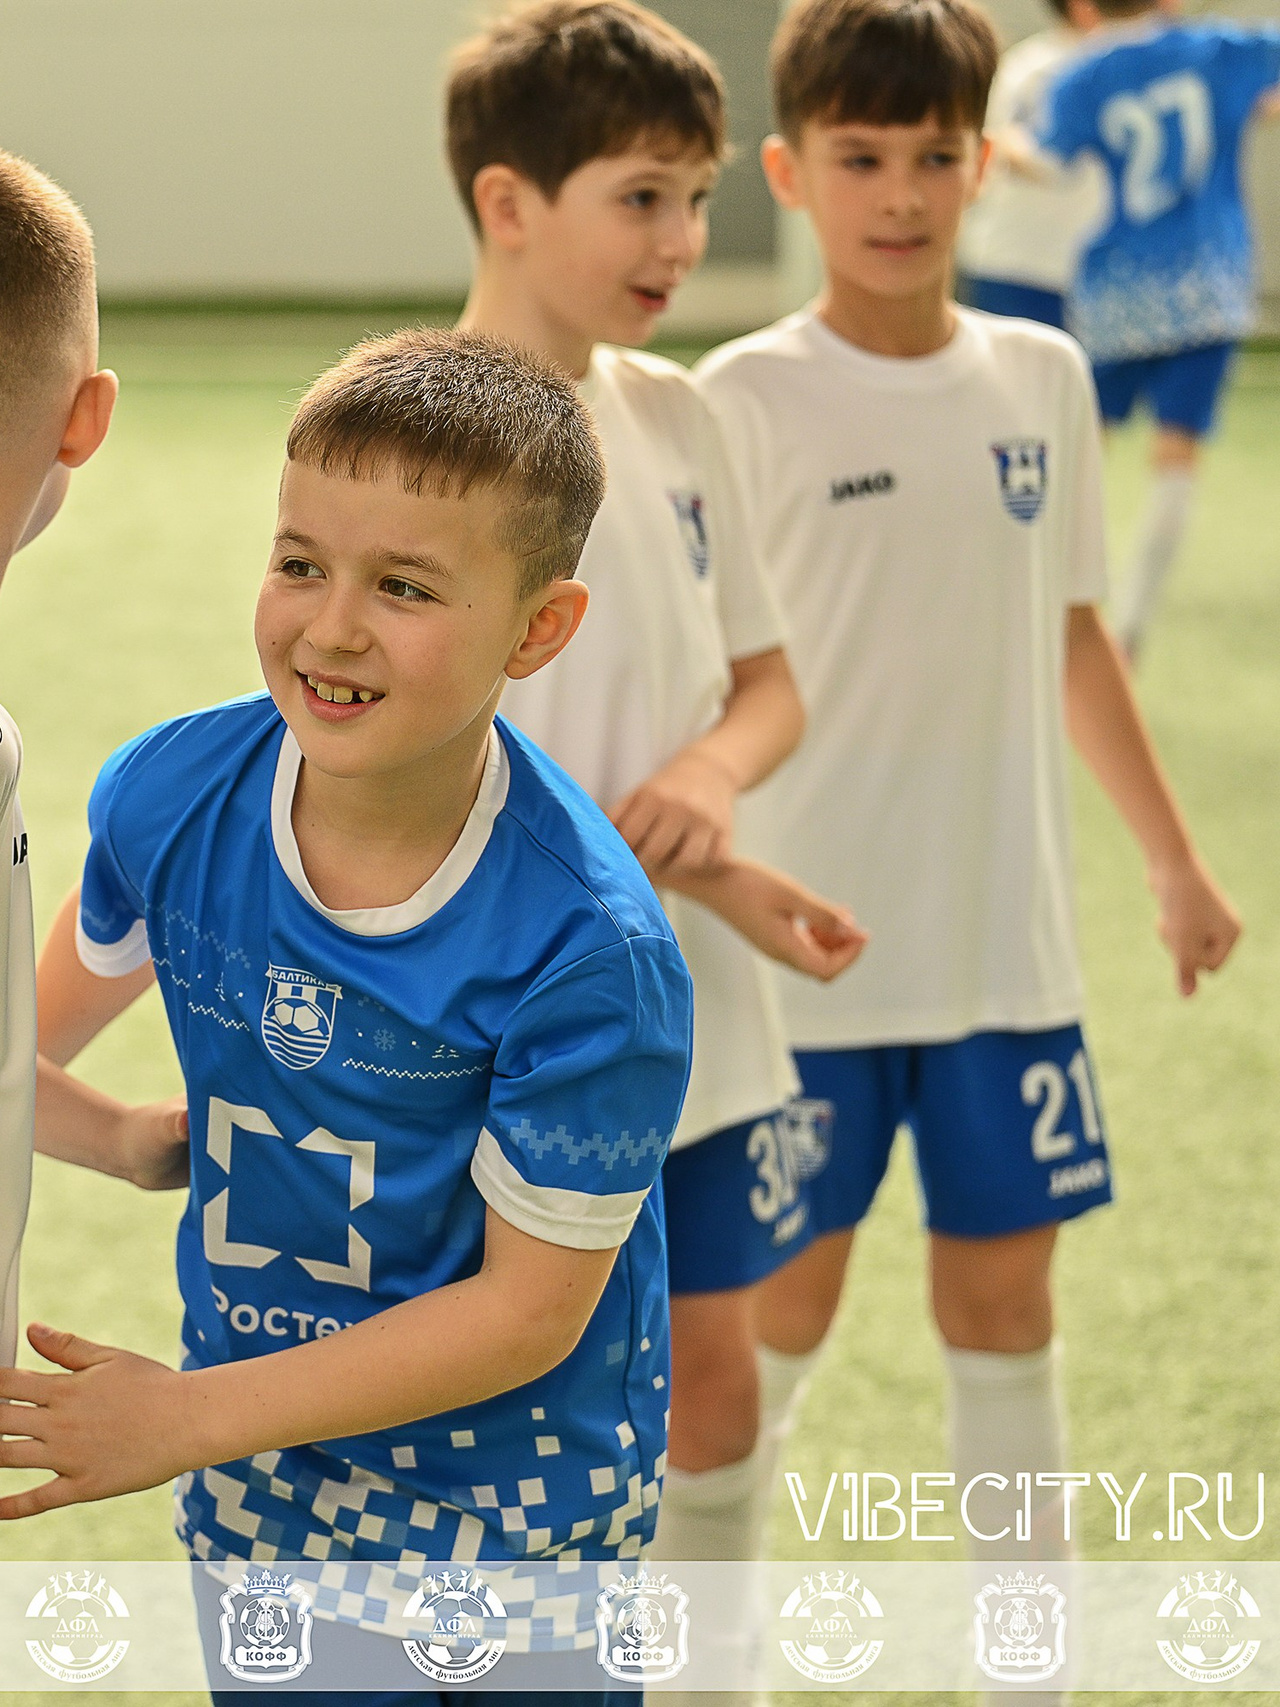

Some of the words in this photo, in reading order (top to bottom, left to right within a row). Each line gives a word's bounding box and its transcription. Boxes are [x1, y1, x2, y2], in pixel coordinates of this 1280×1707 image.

[1099, 72, 1214, 224] 27
[272, 970, 325, 986] БАЛТИКА
[1022, 1050, 1100, 1162] 21
[211, 1284, 353, 1340] осте
